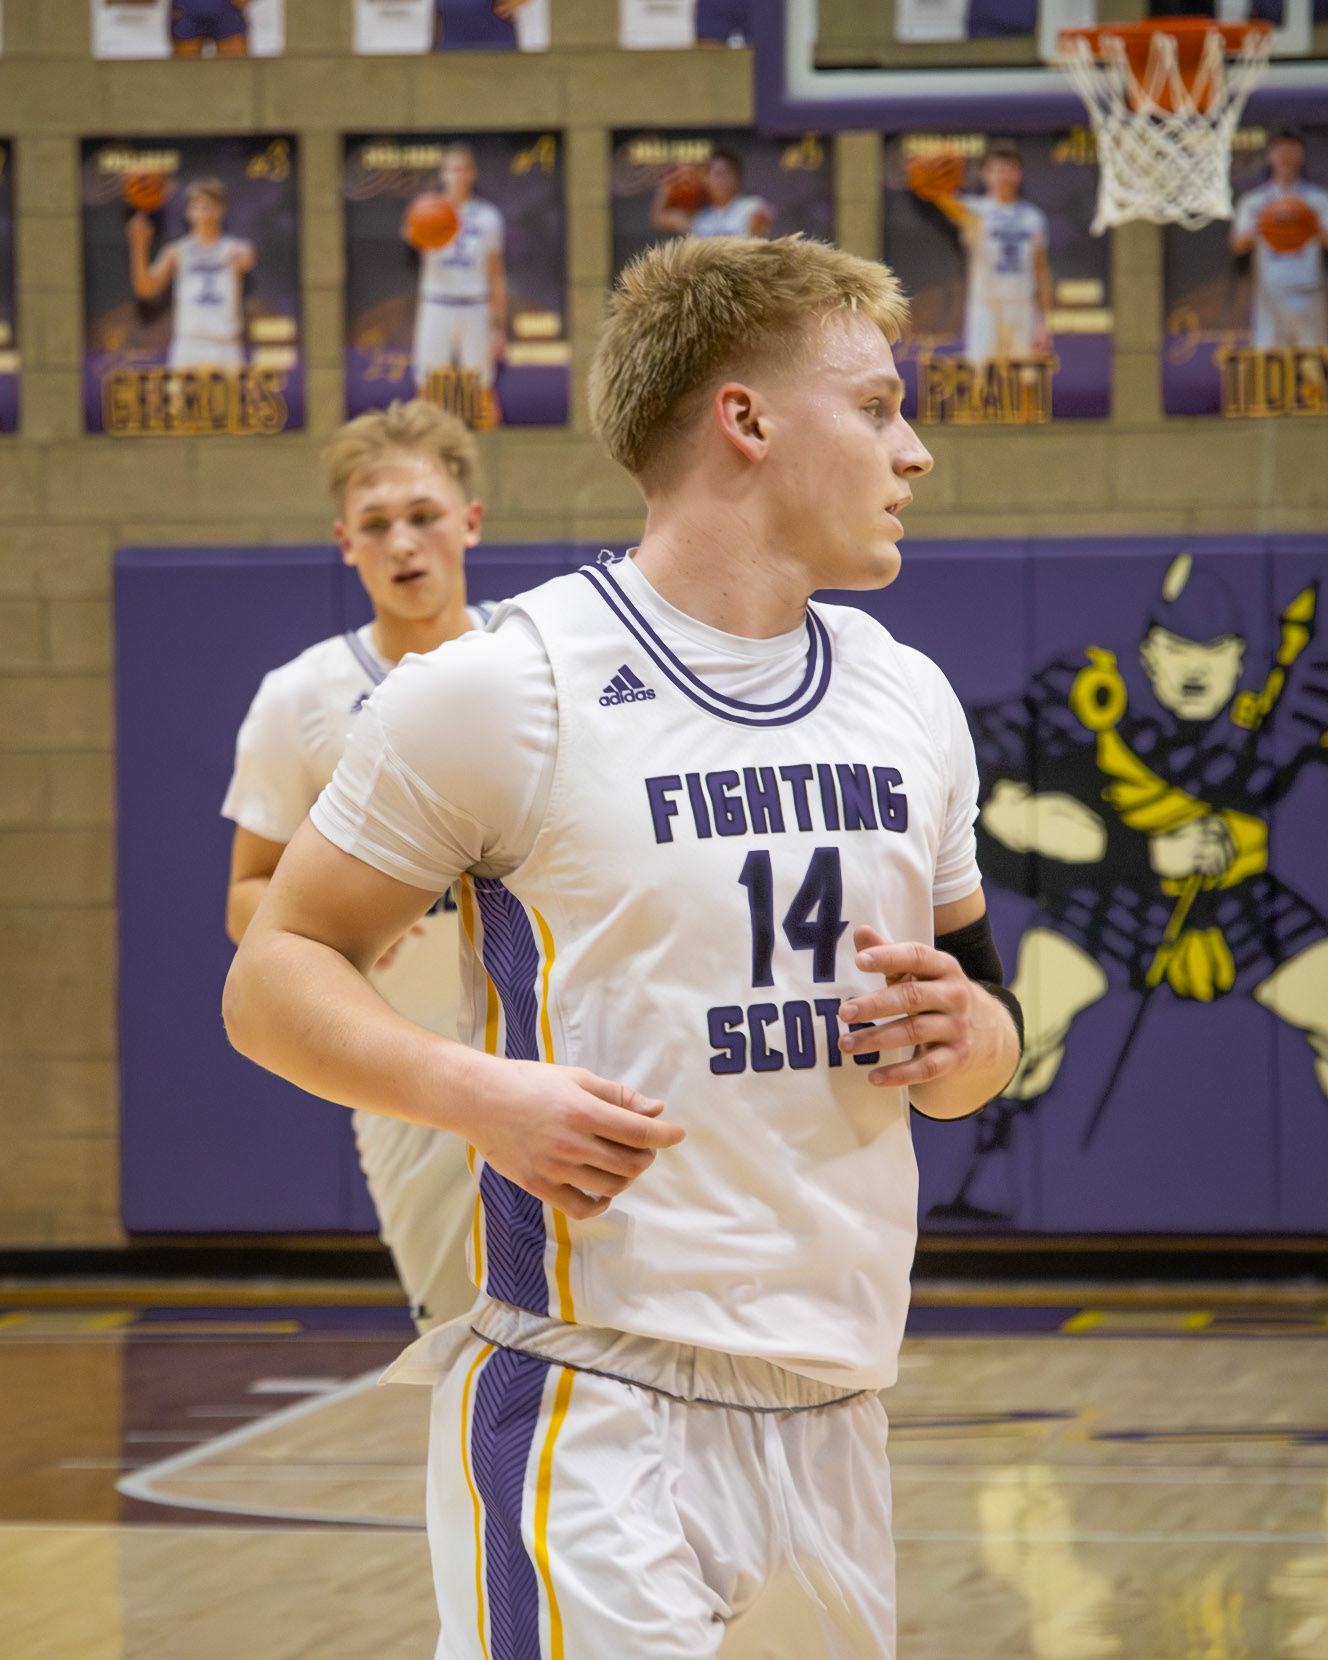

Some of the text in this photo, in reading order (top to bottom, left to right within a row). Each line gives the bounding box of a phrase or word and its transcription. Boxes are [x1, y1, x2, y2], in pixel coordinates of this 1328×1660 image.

[598, 688, 657, 707] adidas
[645, 763, 909, 844] FIGHTING
[738, 846, 849, 988] 14
